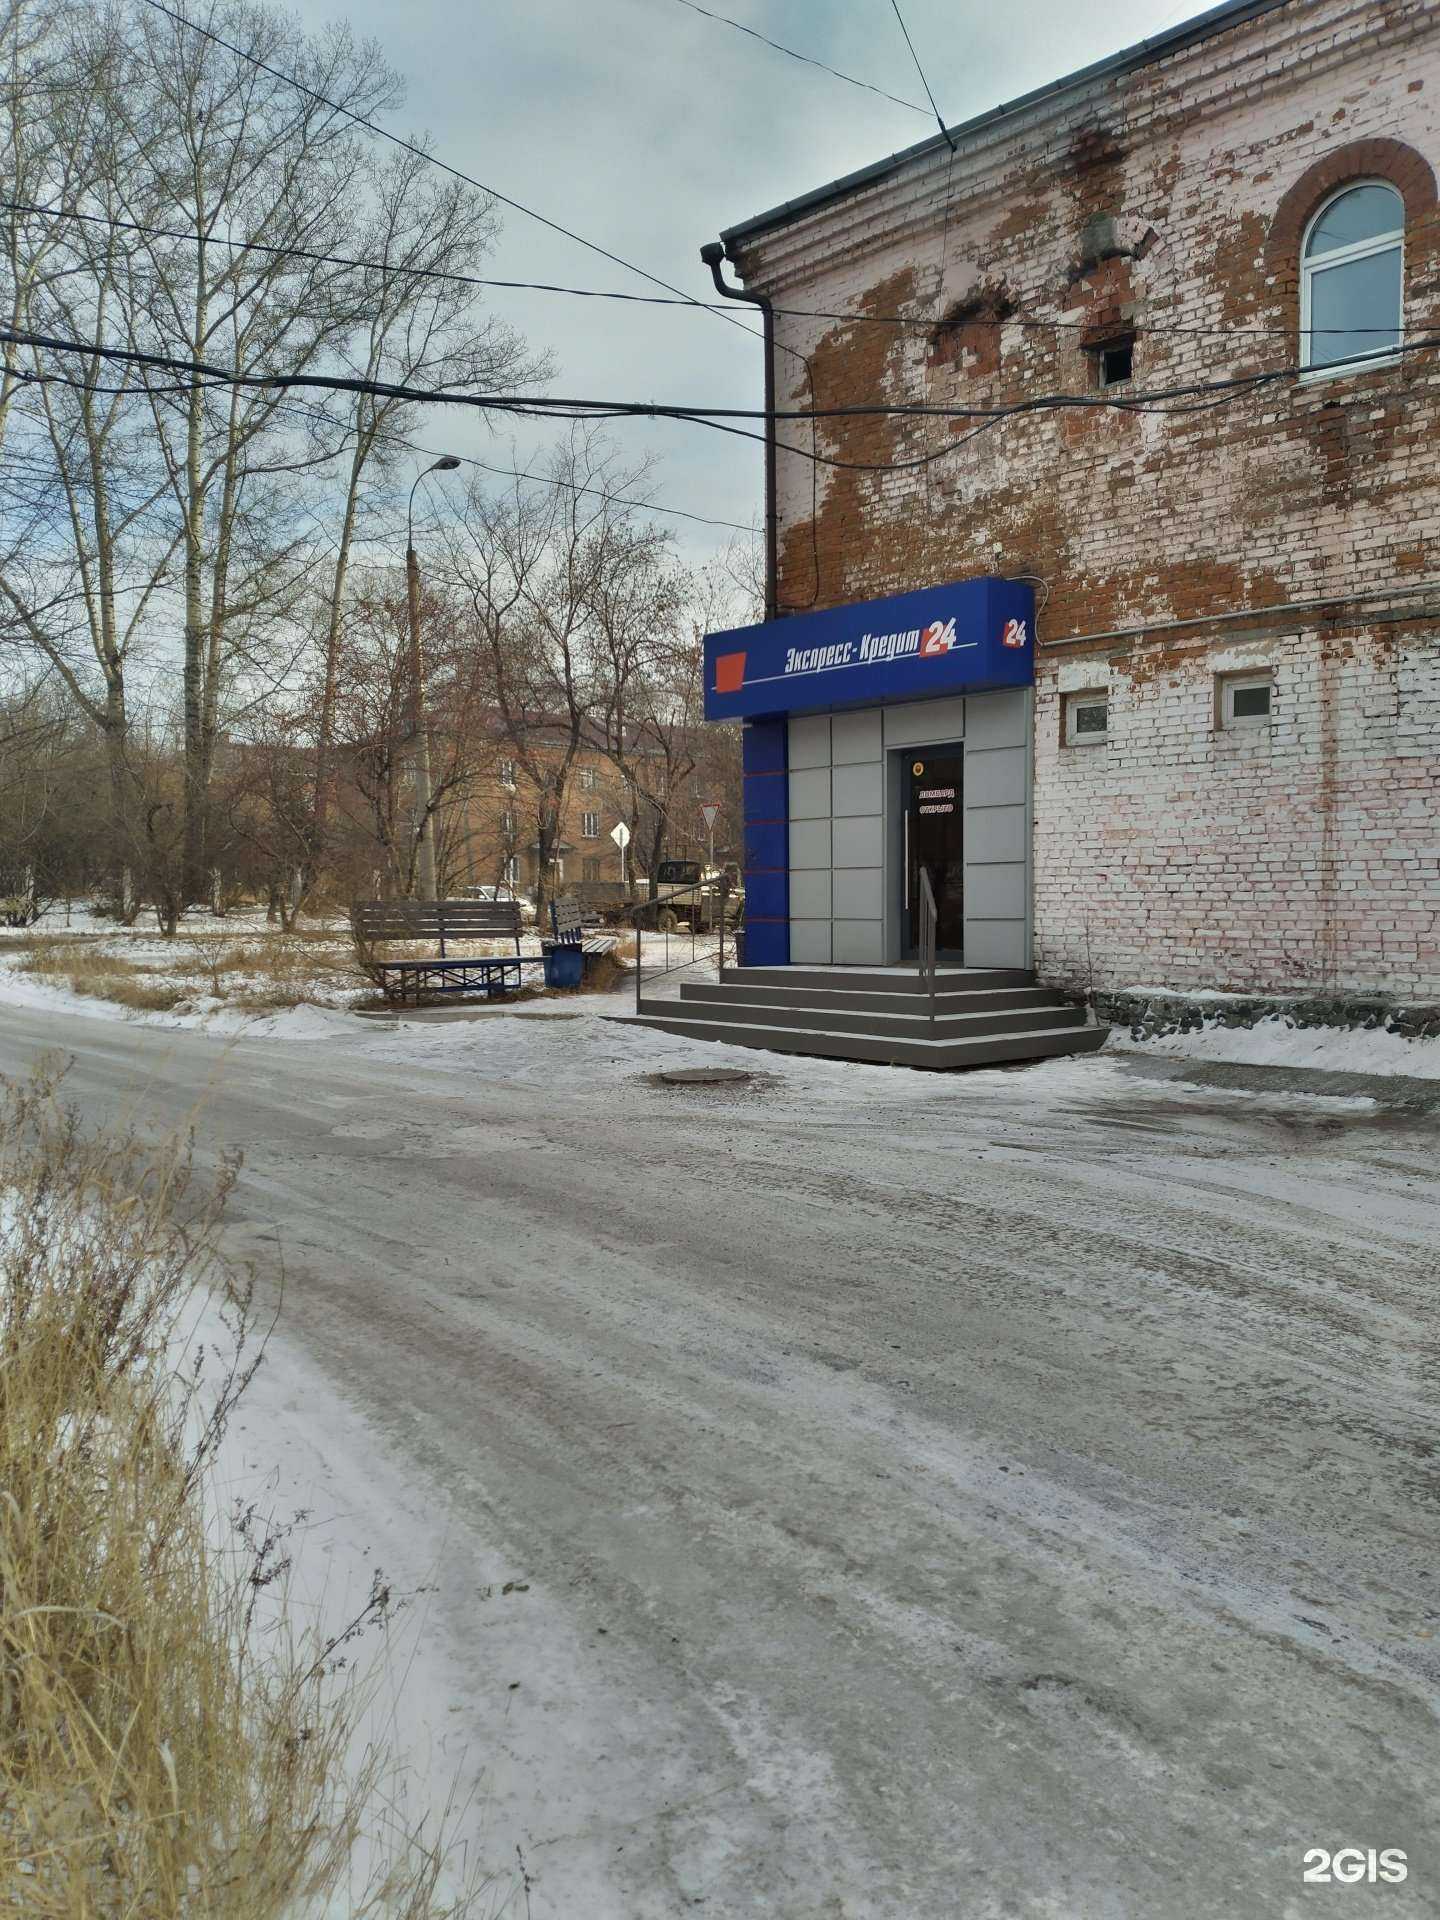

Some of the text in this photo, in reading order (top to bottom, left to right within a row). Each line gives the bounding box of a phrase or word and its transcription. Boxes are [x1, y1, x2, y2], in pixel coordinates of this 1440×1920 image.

[785, 617, 957, 673] Экспресс-Кредит 24
[1006, 618, 1027, 647] 24
